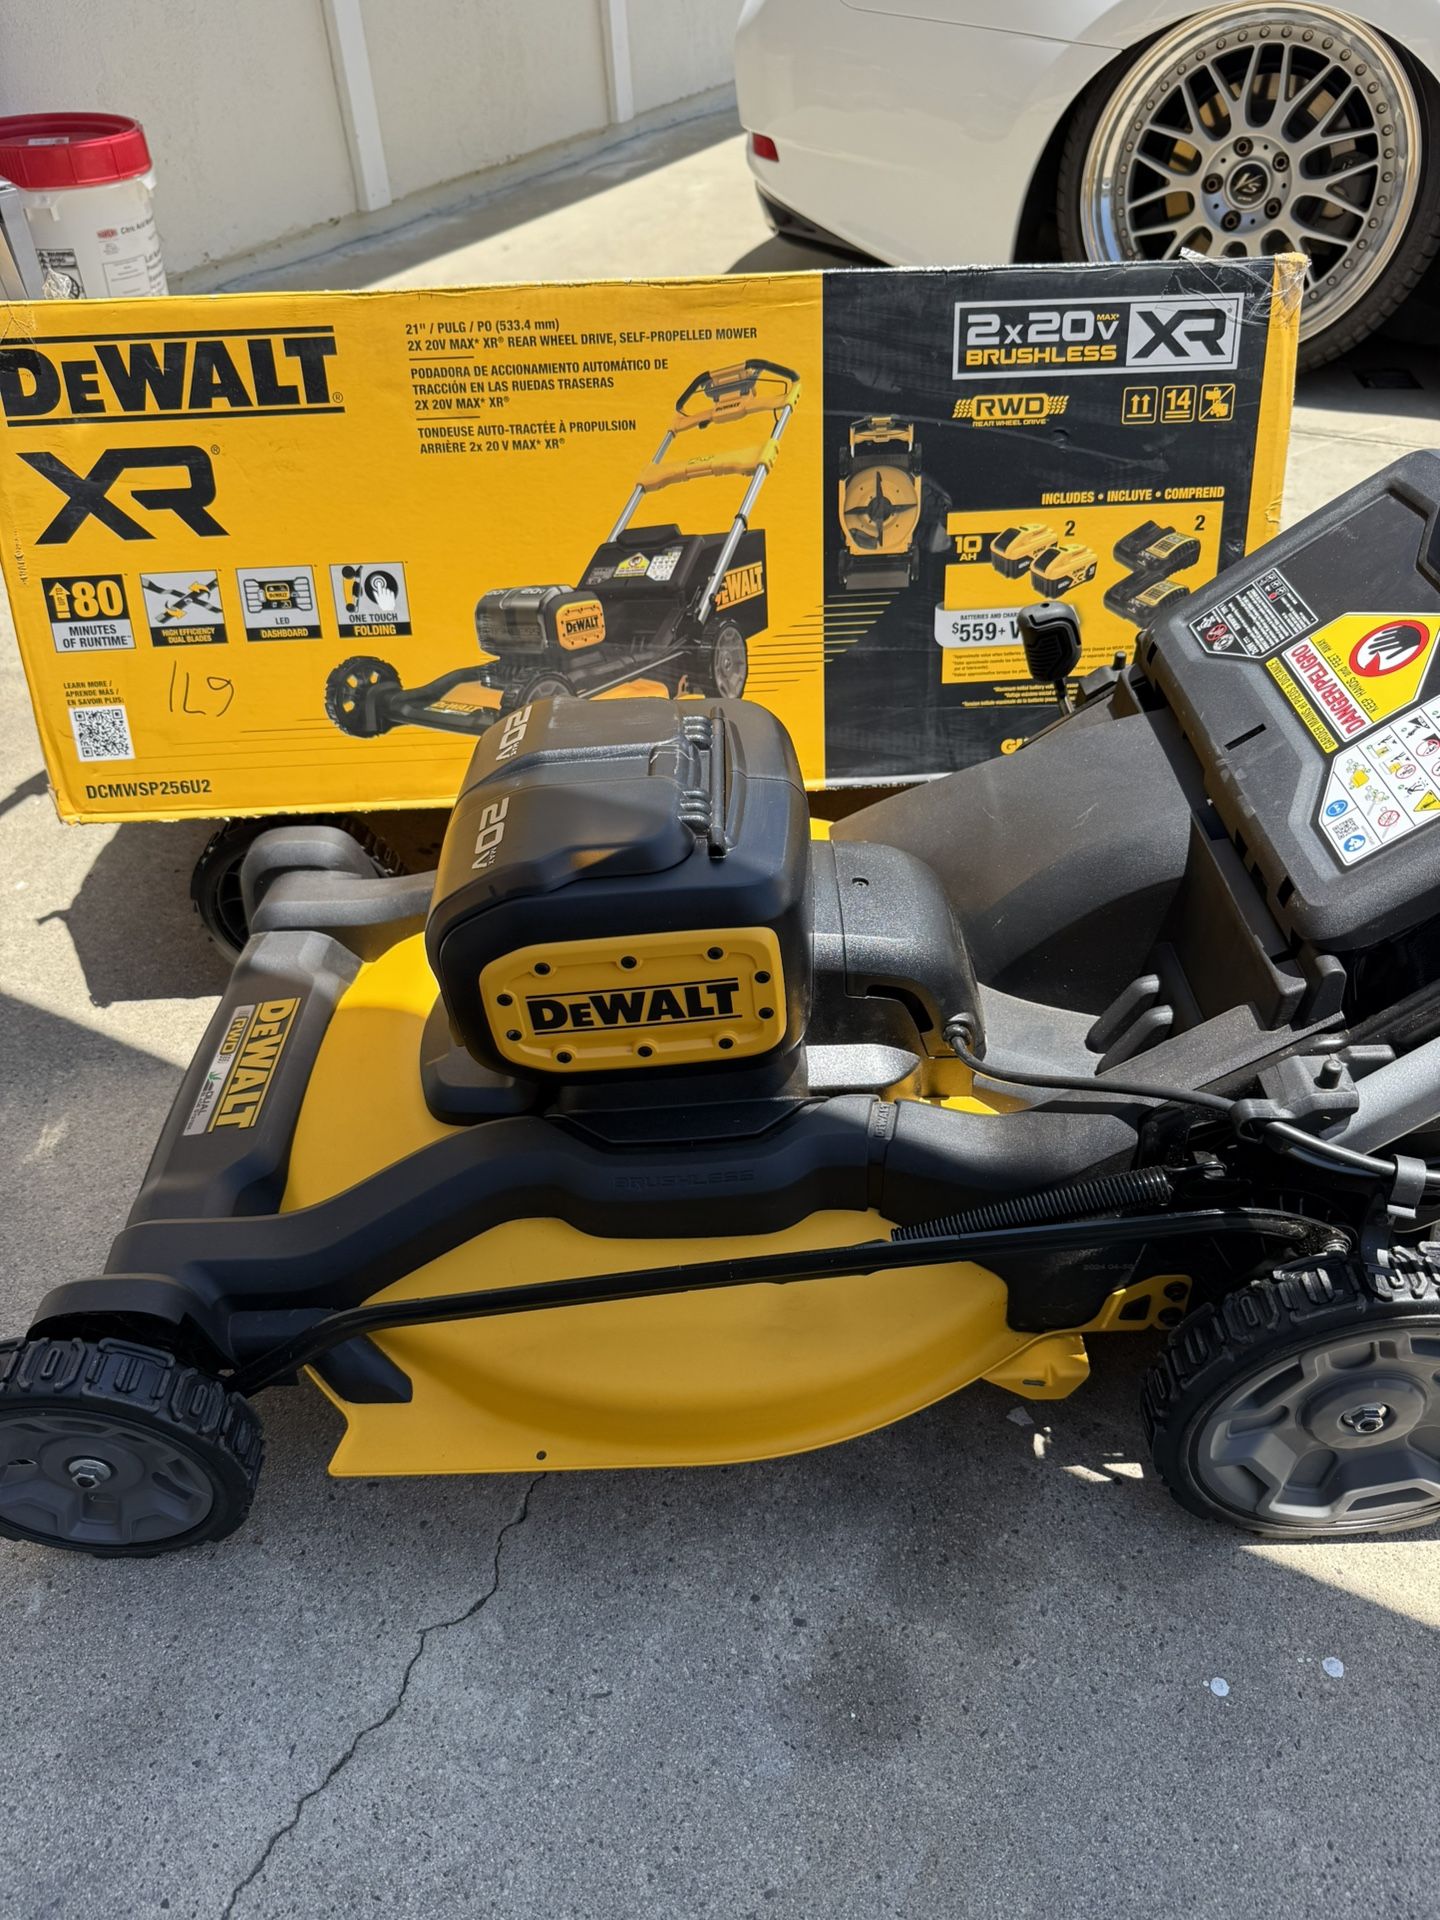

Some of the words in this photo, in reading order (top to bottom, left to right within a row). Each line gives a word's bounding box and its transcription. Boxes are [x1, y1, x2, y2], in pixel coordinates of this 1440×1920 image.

[405, 322, 426, 336] 21"
[437, 321, 467, 334] PULG
[477, 320, 492, 333] PO
[495, 319, 531, 334] (533.4
[534, 317, 560, 332] mm)
[407, 340, 422, 352] 2X
[425, 338, 446, 351] 20V
[508, 335, 537, 348] REAR
[540, 334, 578, 347] WHEEL
[580, 333, 617, 347] DRIVE,
[619, 329, 713, 344] SELF-PROPELLED
[715, 327, 757, 340] MOWER
[965, 344, 1117, 367] BRUSHLESS
[410, 366, 471, 379] PODADORA
[474, 365, 488, 377] DE
[491, 361, 580, 377] ACCIONAMIENTO
[582, 357, 651, 373] AUTOMÁTICO
[654, 358, 669, 370] DE
[413, 380, 467, 395] TRACCIÓN
[470, 381, 485, 393] EN
[488, 380, 509, 392] LAS
[511, 378, 556, 391] RUEDAS
[557, 377, 614, 390] TRASERAS
[415, 399, 429, 411] 2X
[432, 398, 453, 410] 20V
[975, 396, 1045, 417] RWD
[1165, 388, 1192, 412] 14
[417, 426, 475, 439] TONDEUSE
[477, 421, 557, 437] AUTO-TRACTÉE
[558, 419, 567, 433] À
[569, 419, 637, 432] PROPULSION
[972, 420, 995, 428] REAR
[995, 419, 1022, 427] WHEEL
[420, 439, 467, 454] ARRIÈRE
[469, 441, 483, 453] 2x
[486, 440, 500, 452] 20
[502, 440, 509, 451] V
[1041, 491, 1095, 506] INCLUDES
[1106, 488, 1153, 503] INCLUYE
[1164, 486, 1226, 500] COMPREND
[1064, 520, 1076, 537] 2
[1194, 514, 1206, 531] 2
[954, 535, 983, 554] 10
[959, 551, 978, 562] AH
[71, 579, 124, 619] 80
[275, 616, 290, 626] LED
[349, 614, 367, 623] ONE
[369, 612, 399, 622] TOUCH
[960, 613, 989, 621] BATTERIES
[68, 624, 117, 637] MINUTES
[161, 628, 179, 638] HIGH
[179, 627, 215, 637] EFFICIENCY
[168, 635, 186, 644] DUAL
[186, 634, 212, 643] BLADES
[261, 628, 309, 639] DASHBOARD
[354, 624, 397, 637] FOLDING
[62, 638, 77, 649] OF
[1317, 638, 1332, 654] AWAY
[1327, 653, 1342, 667] FEET
[1268, 660, 1290, 687] DISTANCE
[63, 681, 87, 690] LEARN
[87, 680, 108, 688] MORE
[65, 688, 97, 698] APRENDE
[1290, 644, 1366, 734] DANGER/PELIGRO
[1345, 676, 1367, 699] HANDS
[67, 698, 77, 707] EN
[77, 697, 103, 706] SAVOIR
[1288, 687, 1303, 707] PIEDS
[1361, 698, 1379, 714] KEEP
[1303, 706, 1322, 728] MAINS
[1313, 725, 1336, 750] GARDER
[85, 778, 213, 800] DCMWSP256U2
[471, 796, 510, 870] 20V
[524, 979, 740, 1032] DEWALT
[221, 1017, 249, 1054] RWD
[214, 997, 298, 1130] DEWALT
[613, 1169, 754, 1189] BRUSHLESS
